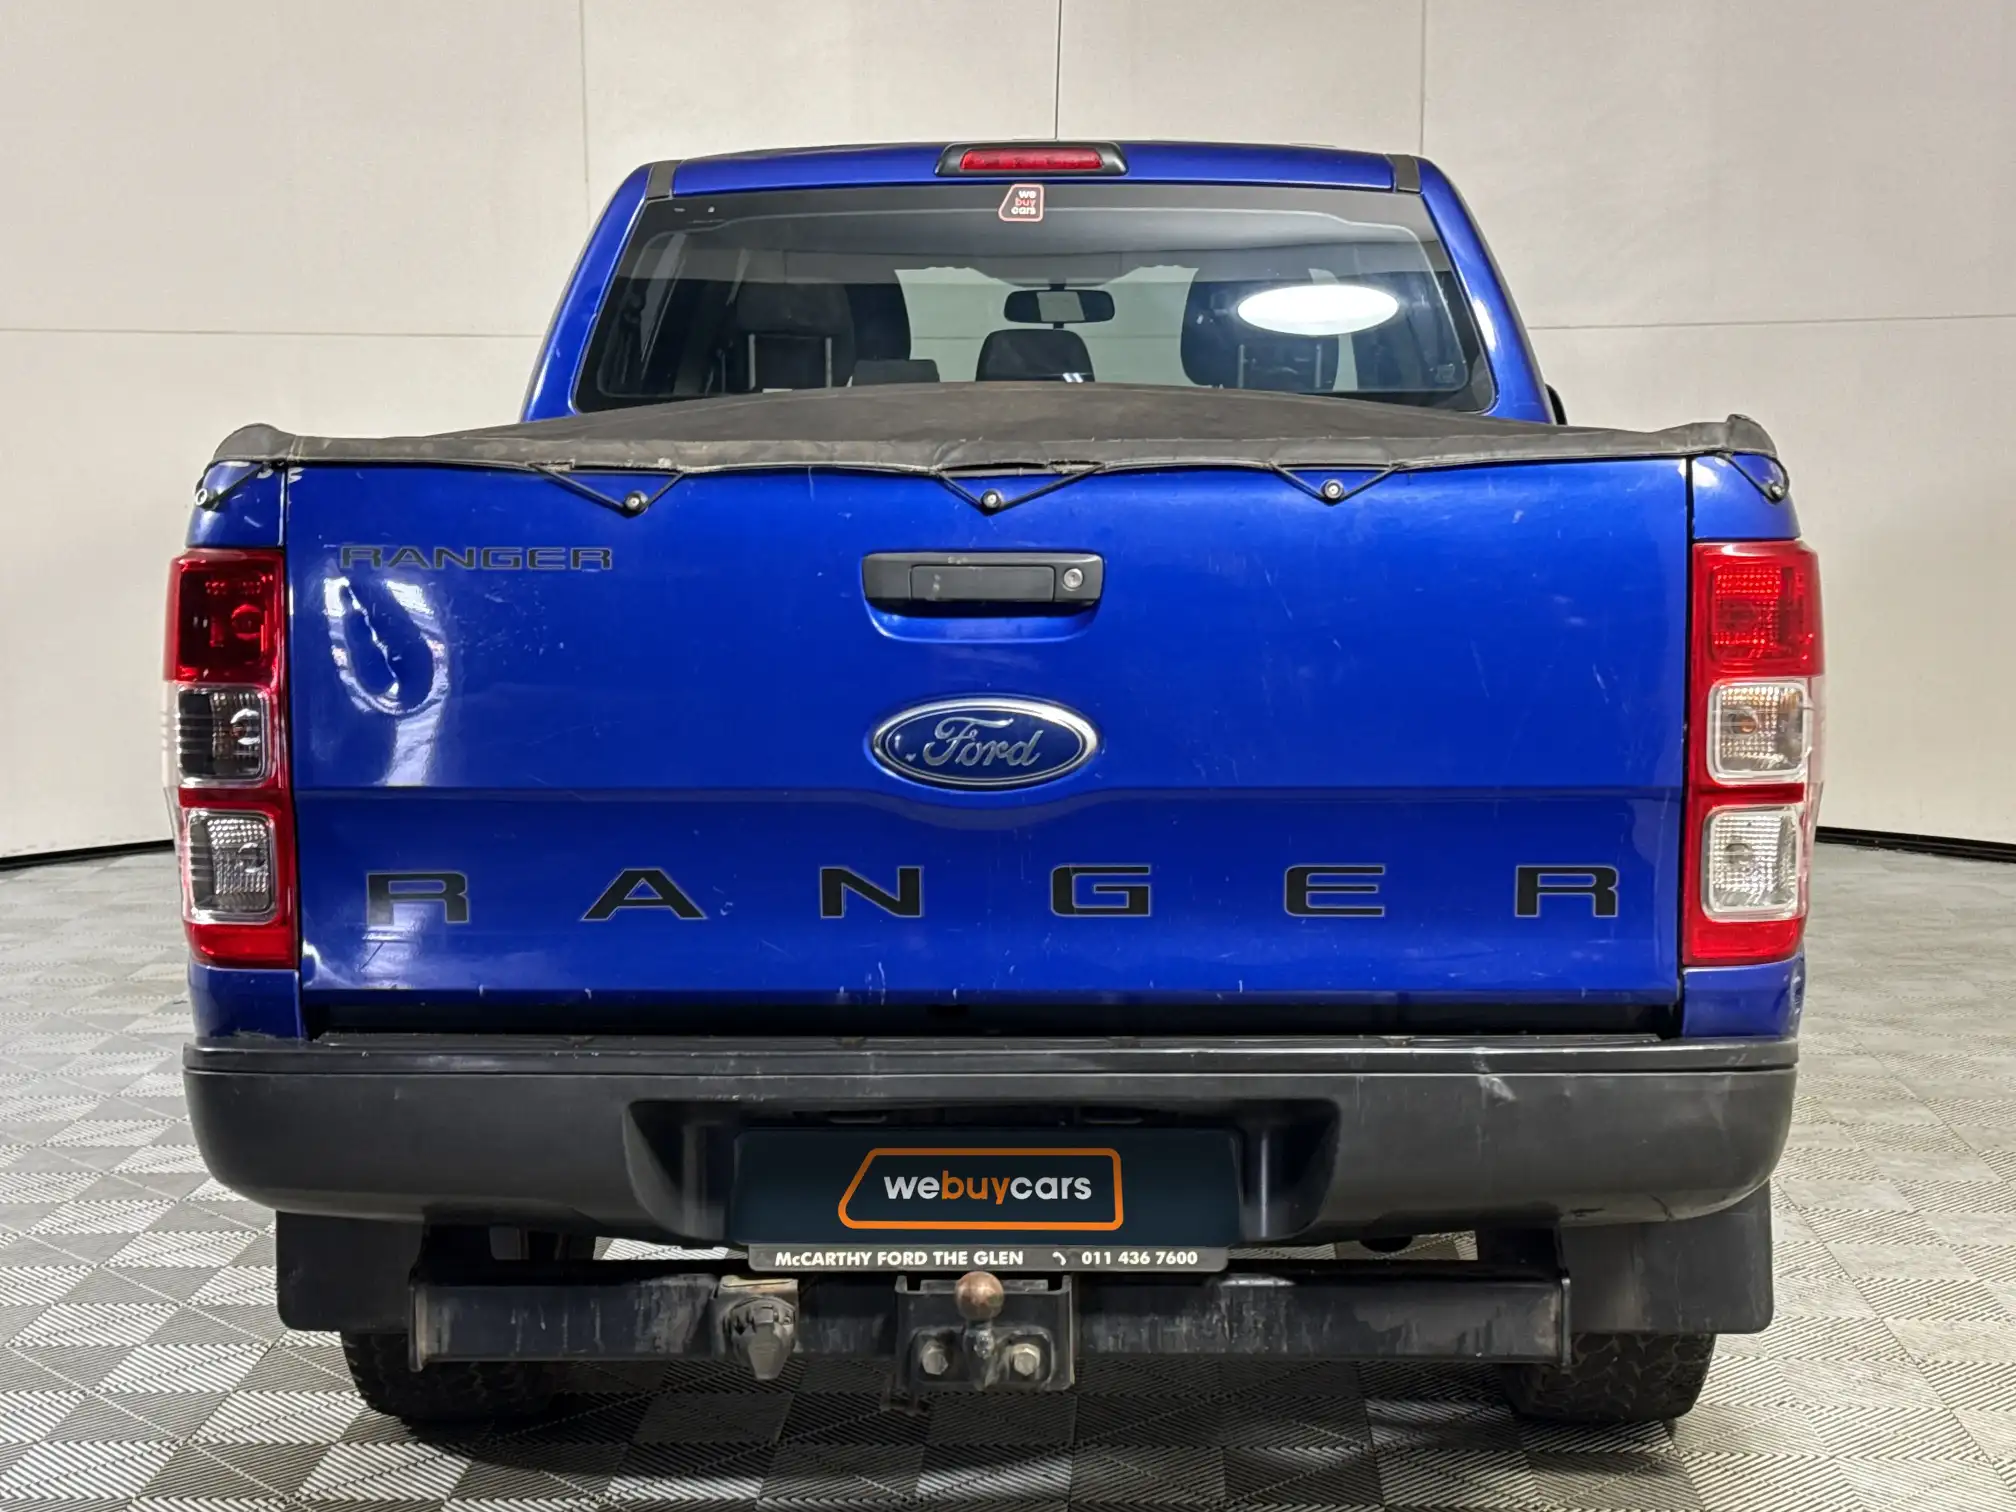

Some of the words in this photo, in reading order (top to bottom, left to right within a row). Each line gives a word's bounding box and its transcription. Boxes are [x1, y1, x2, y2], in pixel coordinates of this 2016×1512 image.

[1015, 197, 1037, 207] buy
[1018, 190, 1037, 199] we
[1011, 206, 1037, 215] cars
[340, 543, 613, 571] RANGER
[922, 716, 1044, 767] Ford
[366, 864, 1620, 926] RANGER
[774, 1251, 873, 1267] McCARTHY
[877, 1251, 928, 1266] FORD
[932, 1251, 968, 1266] THE
[973, 1250, 1024, 1265] GLEN
[1081, 1251, 1111, 1265] 011
[1117, 1251, 1151, 1265] 436
[1155, 1251, 1199, 1265] 7600
